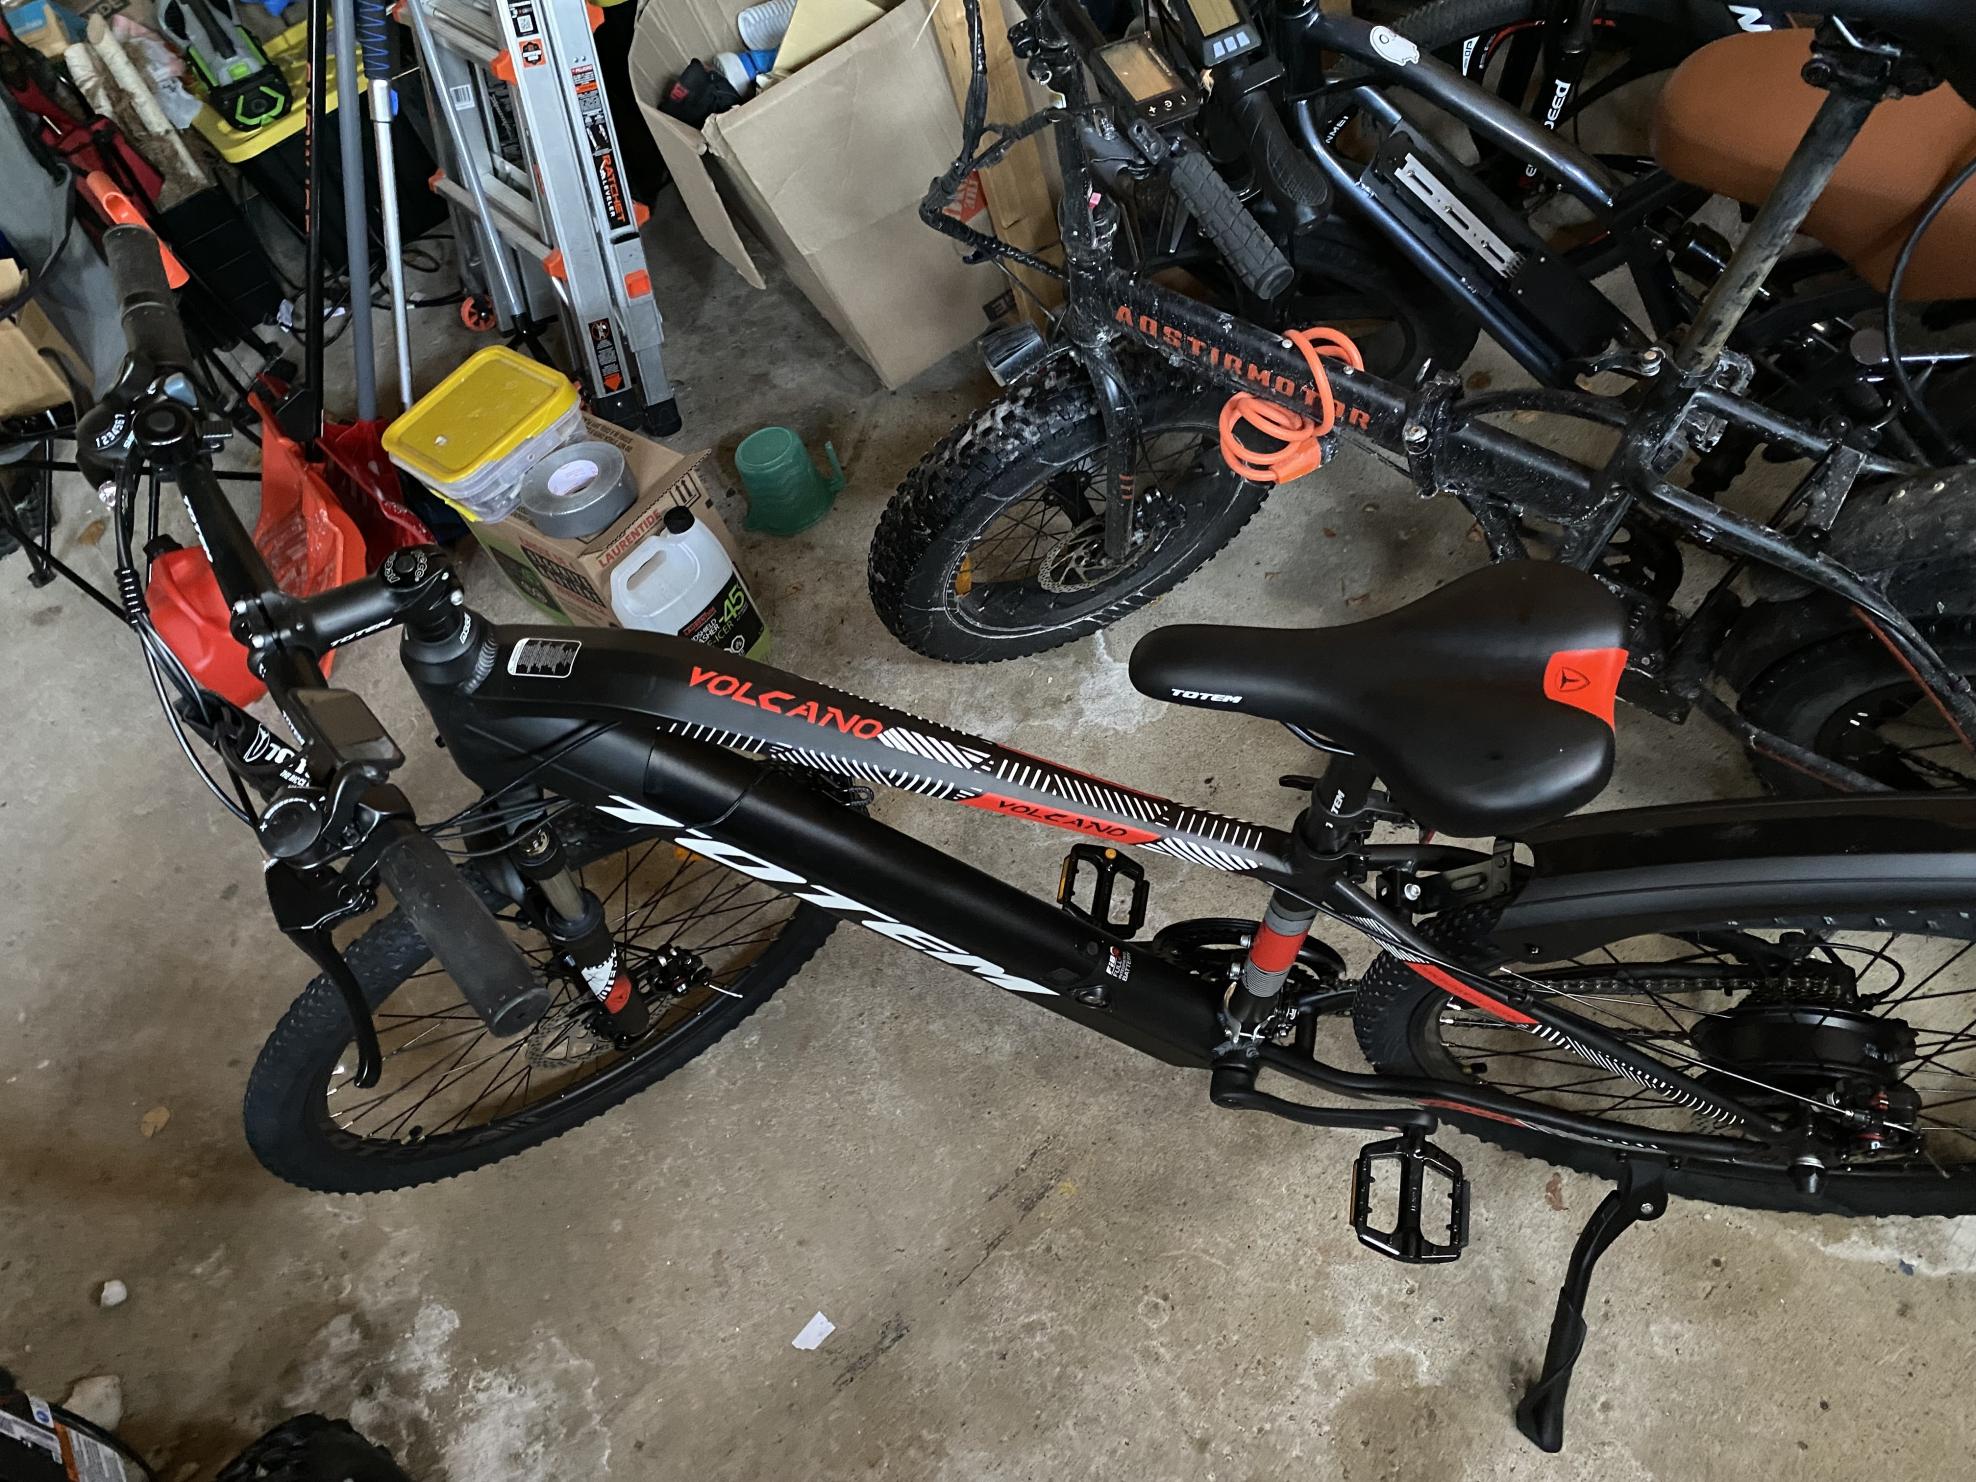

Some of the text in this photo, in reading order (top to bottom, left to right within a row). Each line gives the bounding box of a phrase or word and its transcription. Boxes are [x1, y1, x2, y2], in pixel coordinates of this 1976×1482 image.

[602, 154, 626, 223] RATCHET
[598, 510, 662, 568] LAURENTIDE
[688, 666, 885, 740] VOLCANO
[1171, 688, 1243, 704] TOTEM
[997, 799, 1128, 838] VOLCANO
[595, 795, 1060, 996] TOTEM
[1112, 959, 1122, 977] FULL
[1122, 951, 1132, 982] BATTERY
